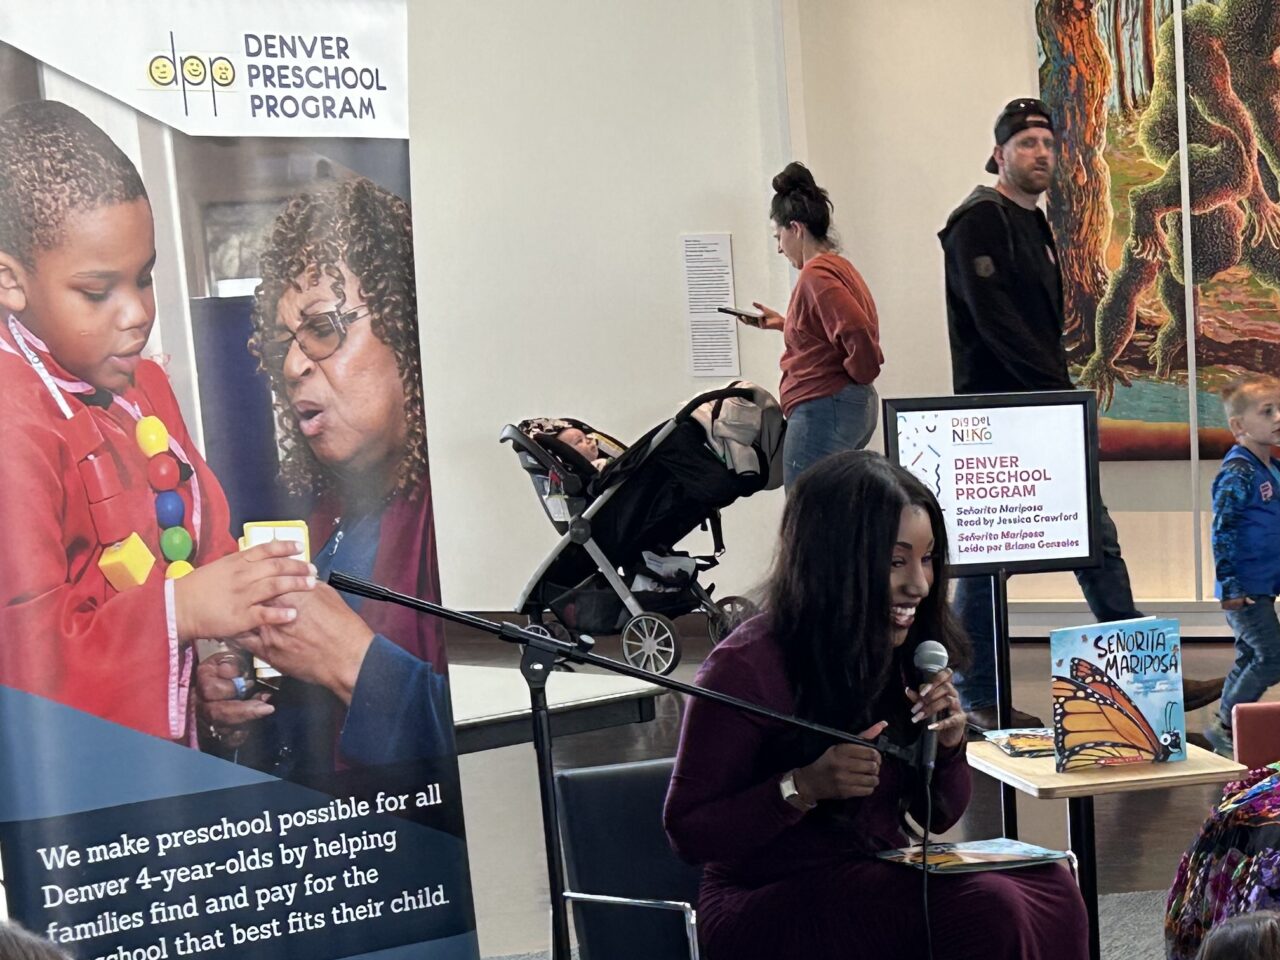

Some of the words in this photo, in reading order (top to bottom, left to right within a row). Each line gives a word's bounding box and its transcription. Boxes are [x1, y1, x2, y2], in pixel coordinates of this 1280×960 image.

[244, 33, 350, 59] DENVER
[149, 31, 236, 117] dpp
[247, 63, 387, 91] PRESCHOOL
[250, 94, 376, 119] PROGRAM
[954, 455, 1019, 470] DENVER
[955, 469, 1052, 485] PRESCHOOL
[956, 485, 1037, 500] PROGRAM
[956, 505, 998, 516] Señorita
[999, 504, 1044, 514] Mariposa
[957, 517, 982, 527] Read
[983, 517, 995, 528] by
[997, 515, 1032, 525] Jessica
[1033, 512, 1079, 523] Crawford
[957, 531, 999, 542] Señorita
[1000, 529, 1045, 540] Mariposa
[958, 543, 985, 553] Leído
[986, 544, 1002, 554] por
[1004, 541, 1036, 551] Briana
[1093, 628, 1166, 658] SEÑORITA
[1105, 652, 1179, 679] MARIPOSA
[36, 844, 81, 870] We
[86, 833, 150, 864] make
[156, 811, 272, 857] preschool
[278, 796, 370, 836] possible
[375, 792, 409, 814] for
[415, 783, 443, 807] all
[41, 876, 130, 908] Denver
[135, 848, 273, 892] 4-year-olds
[279, 843, 308, 869] by
[313, 830, 397, 859] helping
[46, 911, 144, 944] families
[149, 895, 199, 925] find
[205, 886, 249, 914] and
[255, 881, 298, 911] pay
[303, 873, 337, 896] for
[342, 866, 379, 889] the
[174, 929, 226, 955] that
[230, 917, 282, 945] best
[287, 911, 326, 934] fits
[331, 898, 385, 925] their
[390, 884, 450, 915] child.
